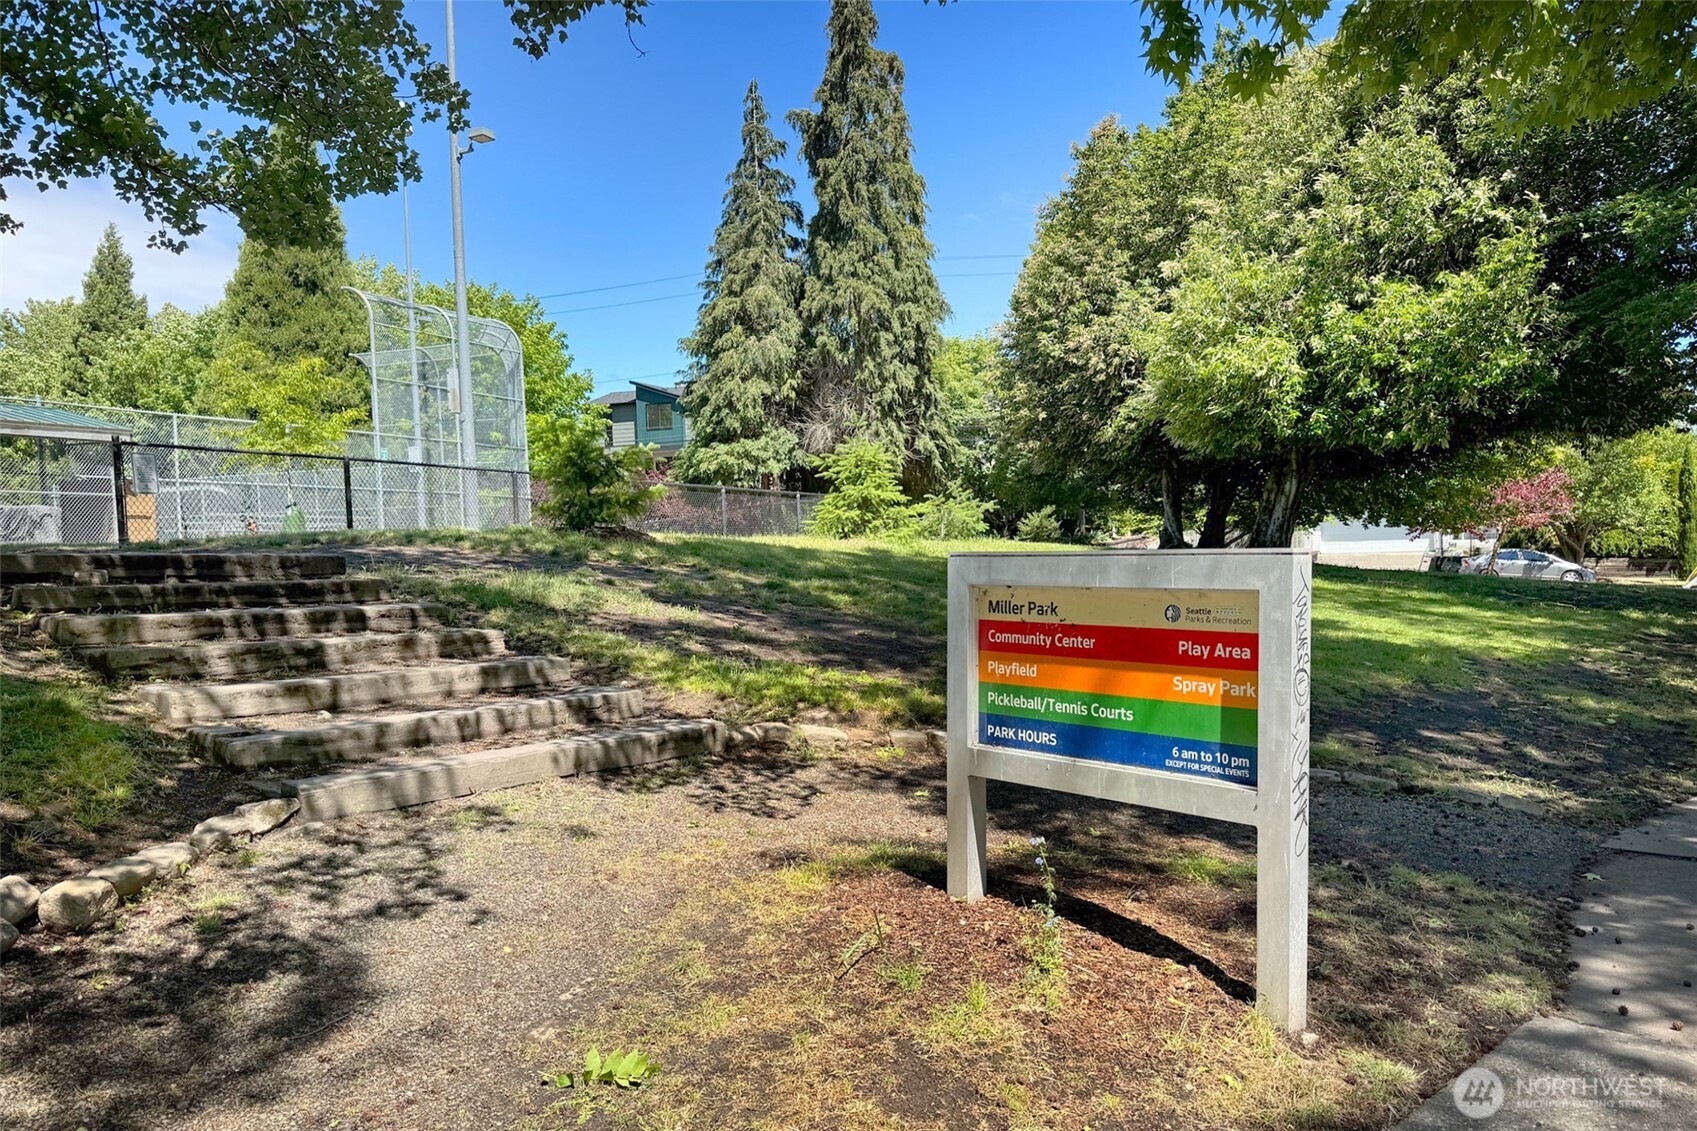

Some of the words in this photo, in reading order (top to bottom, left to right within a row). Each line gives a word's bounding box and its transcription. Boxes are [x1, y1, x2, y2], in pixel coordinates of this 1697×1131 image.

[988, 599, 1025, 616] Miller
[1027, 600, 1058, 617] Park
[1185, 606, 1212, 616] Seattle
[1185, 616, 1205, 624] Parks
[1205, 616, 1211, 624] &
[1212, 616, 1252, 626] Recreation
[987, 629, 1052, 648] Community
[1054, 633, 1096, 649] Center
[1177, 640, 1211, 660] Play
[1214, 643, 1252, 660] Area
[987, 661, 1038, 678] Playfield
[1172, 676, 1217, 697] Spray
[1219, 680, 1257, 698] Park
[987, 691, 1088, 716] Pickleball/Tennis
[1090, 703, 1134, 722] Courts
[987, 725, 1016, 741] PARK
[1018, 728, 1057, 746] HOURS
[1172, 746, 1179, 758] 6
[1181, 750, 1198, 760] am
[1200, 751, 1213, 762] to
[1215, 752, 1229, 765] 10
[1231, 756, 1250, 768] pm
[1165, 759, 1187, 769] EXCEPT
[1187, 762, 1200, 770] FOR
[1200, 765, 1224, 774] SPECIAL
[1225, 768, 1250, 778] EVENTS
